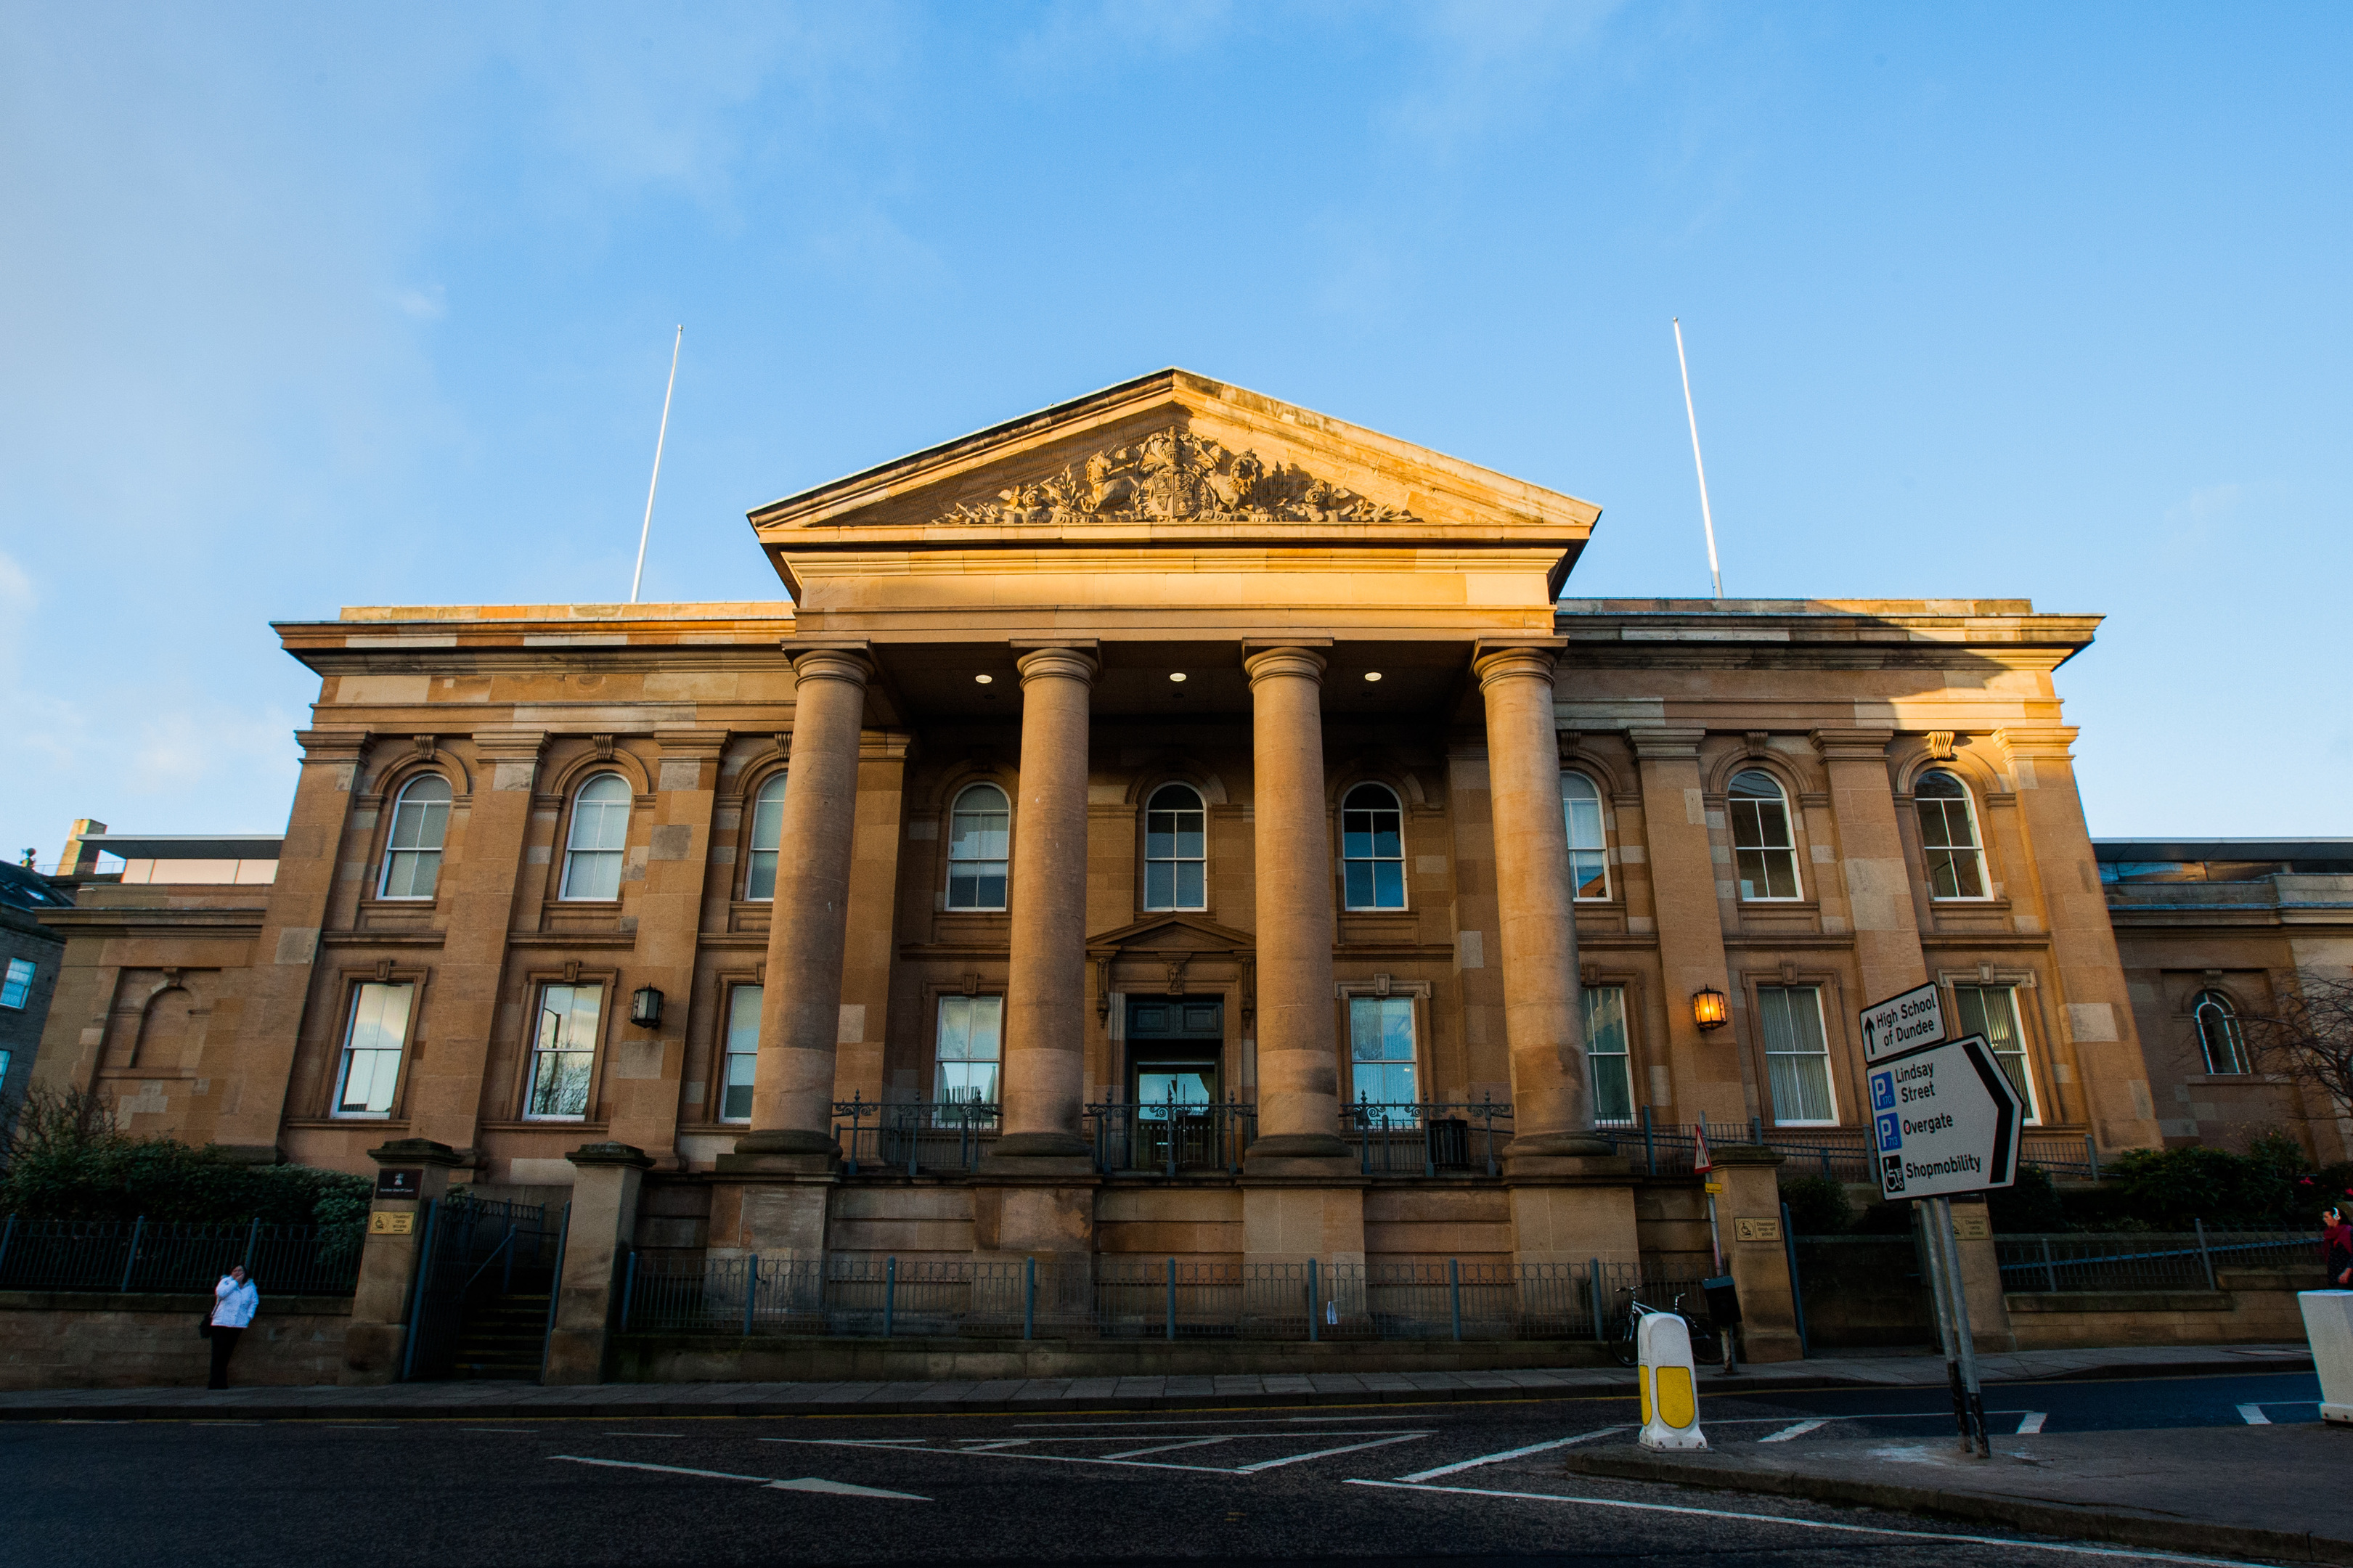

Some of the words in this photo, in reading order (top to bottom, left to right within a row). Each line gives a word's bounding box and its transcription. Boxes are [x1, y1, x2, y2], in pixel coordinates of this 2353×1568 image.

[1876, 1008, 1899, 1028] High
[1900, 992, 1936, 1019] School
[1883, 1029, 1893, 1047] of
[1896, 1019, 1935, 1042] Dundee
[1895, 1062, 1934, 1083] Lindsay
[1874, 1077, 1886, 1107] P
[1883, 1095, 1893, 1104] 170
[1901, 1080, 1936, 1103] Street
[1880, 1119, 1892, 1148] P
[1903, 1112, 1954, 1135] Overgate
[1888, 1135, 1899, 1146] 713
[1906, 1153, 1981, 1179] Shopmobility
